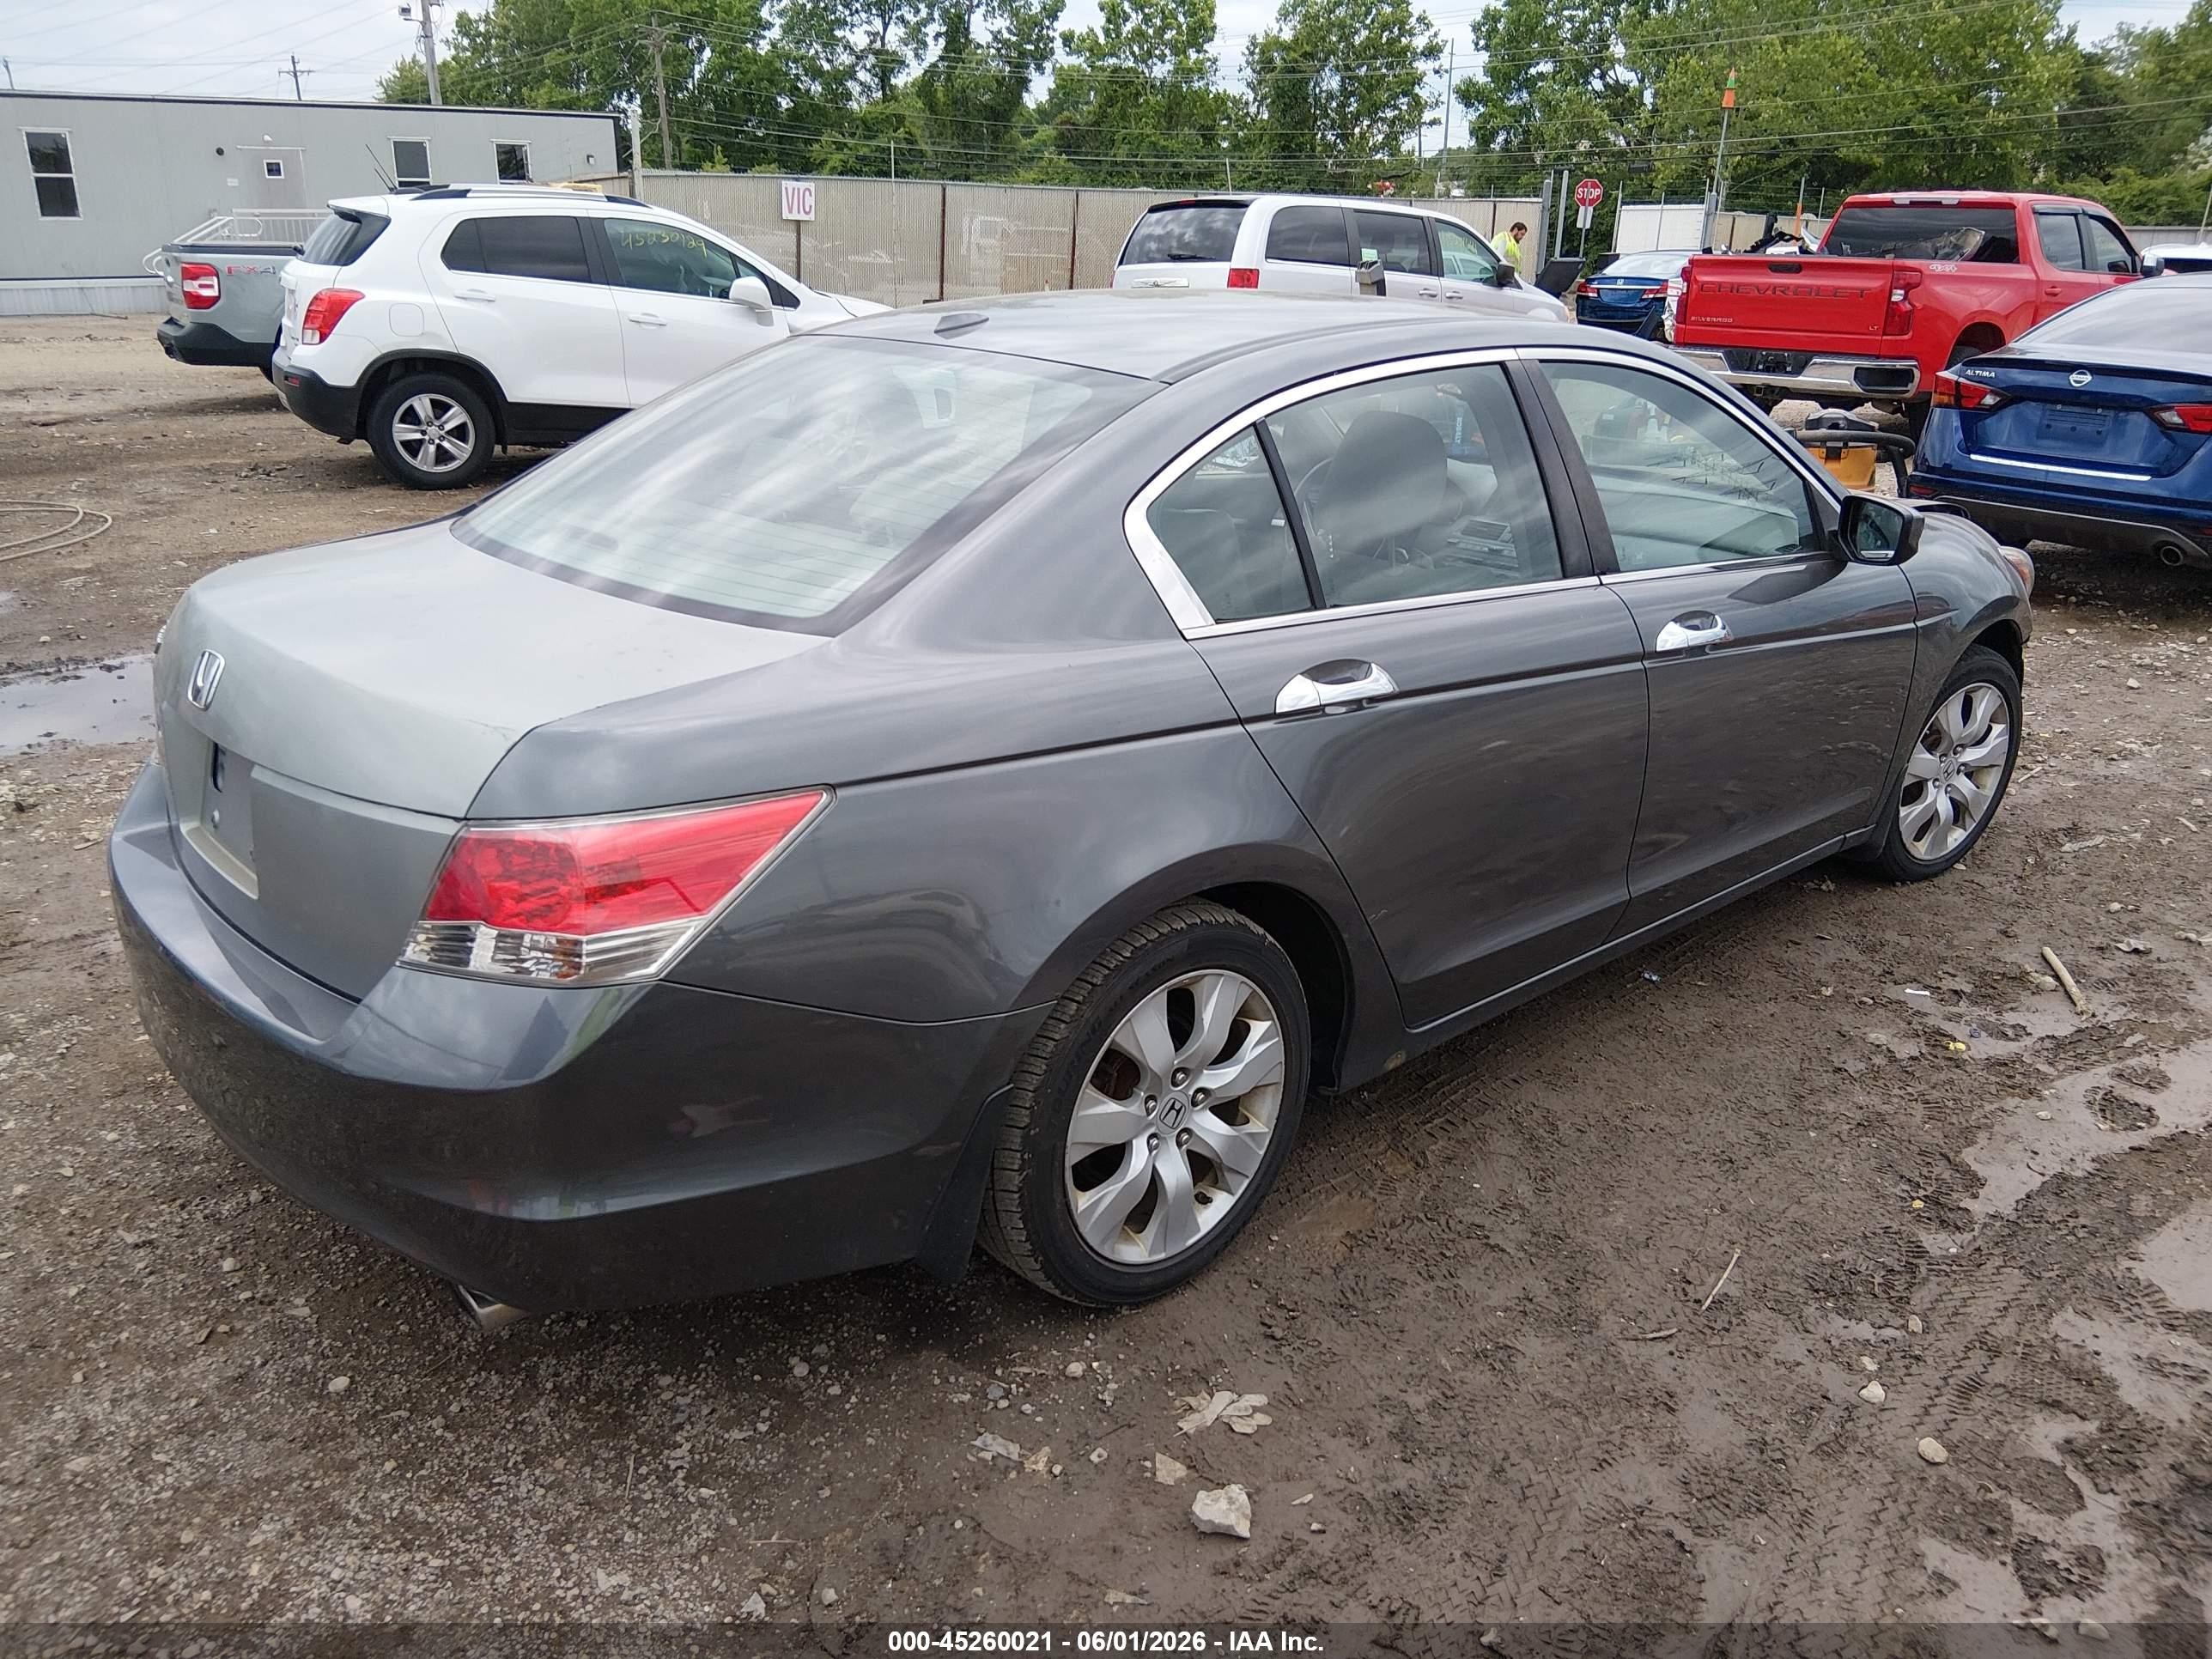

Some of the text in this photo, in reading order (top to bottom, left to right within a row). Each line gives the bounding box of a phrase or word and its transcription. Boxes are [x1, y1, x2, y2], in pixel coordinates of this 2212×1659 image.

[1577, 188, 1601, 199] STOP
[785, 186, 812, 216] VIC
[1700, 282, 1872, 299] CHEVROLET
[1965, 369, 1996, 378] ALTIMA
